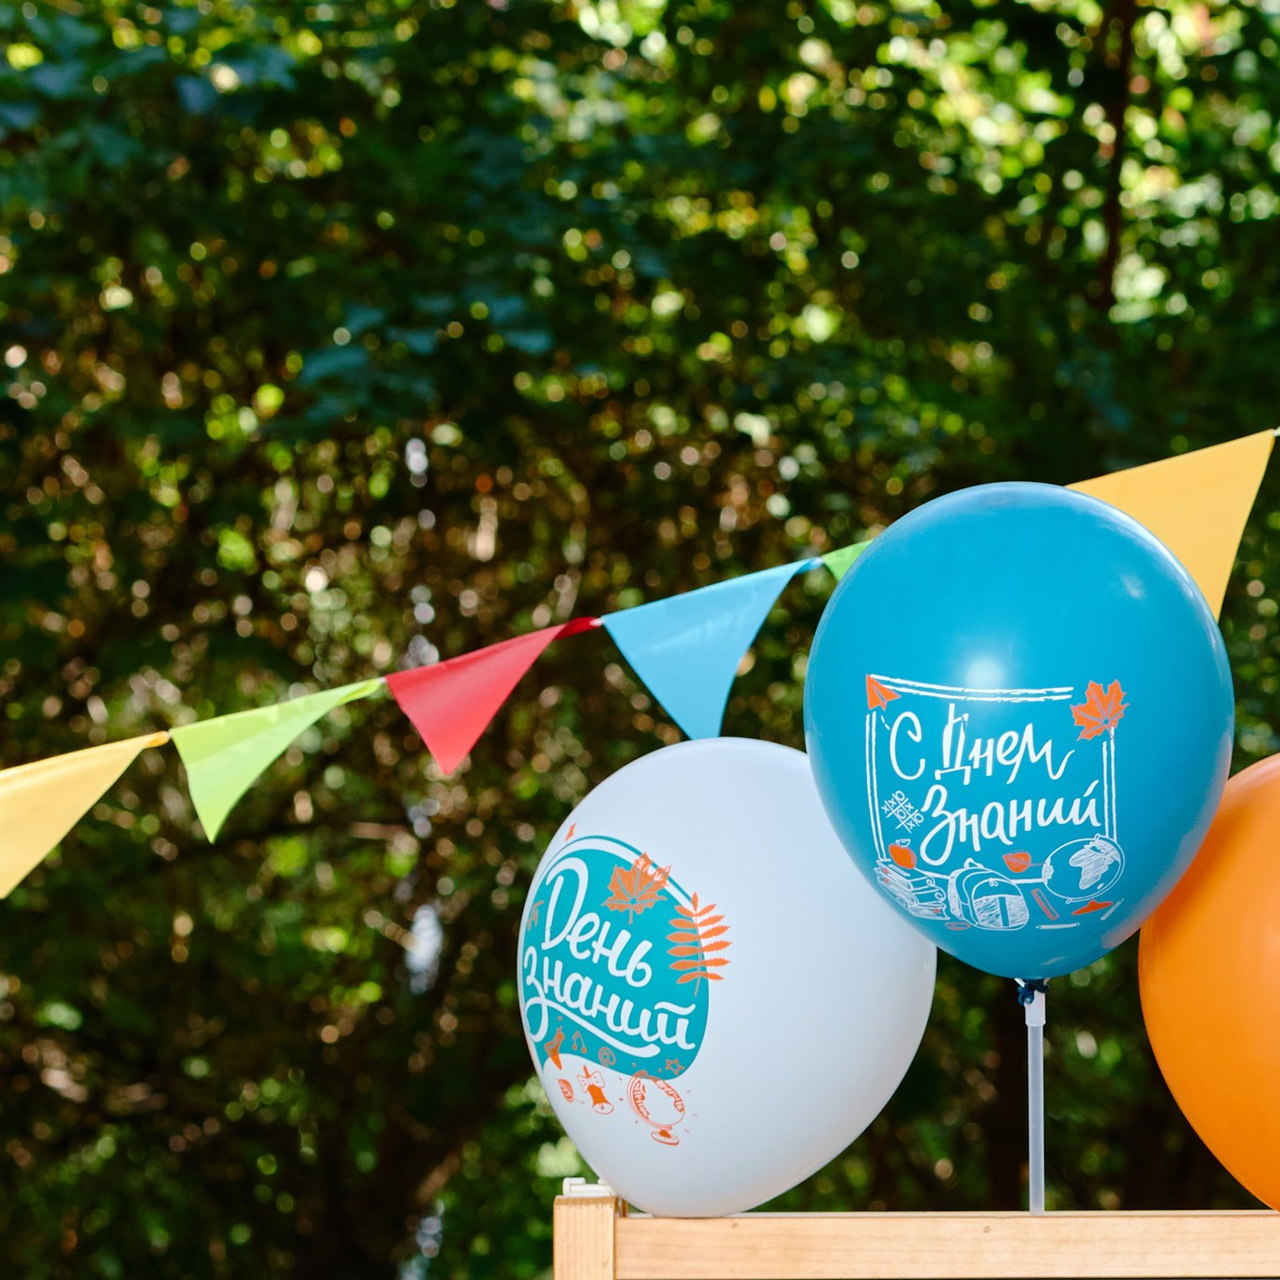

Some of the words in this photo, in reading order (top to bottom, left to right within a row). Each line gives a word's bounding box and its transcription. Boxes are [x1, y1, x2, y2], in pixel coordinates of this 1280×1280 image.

[889, 710, 926, 781] С
[934, 702, 1076, 786] Днем
[919, 779, 1102, 867] Знаний
[540, 856, 653, 988] День
[522, 945, 696, 1058] Знаний
